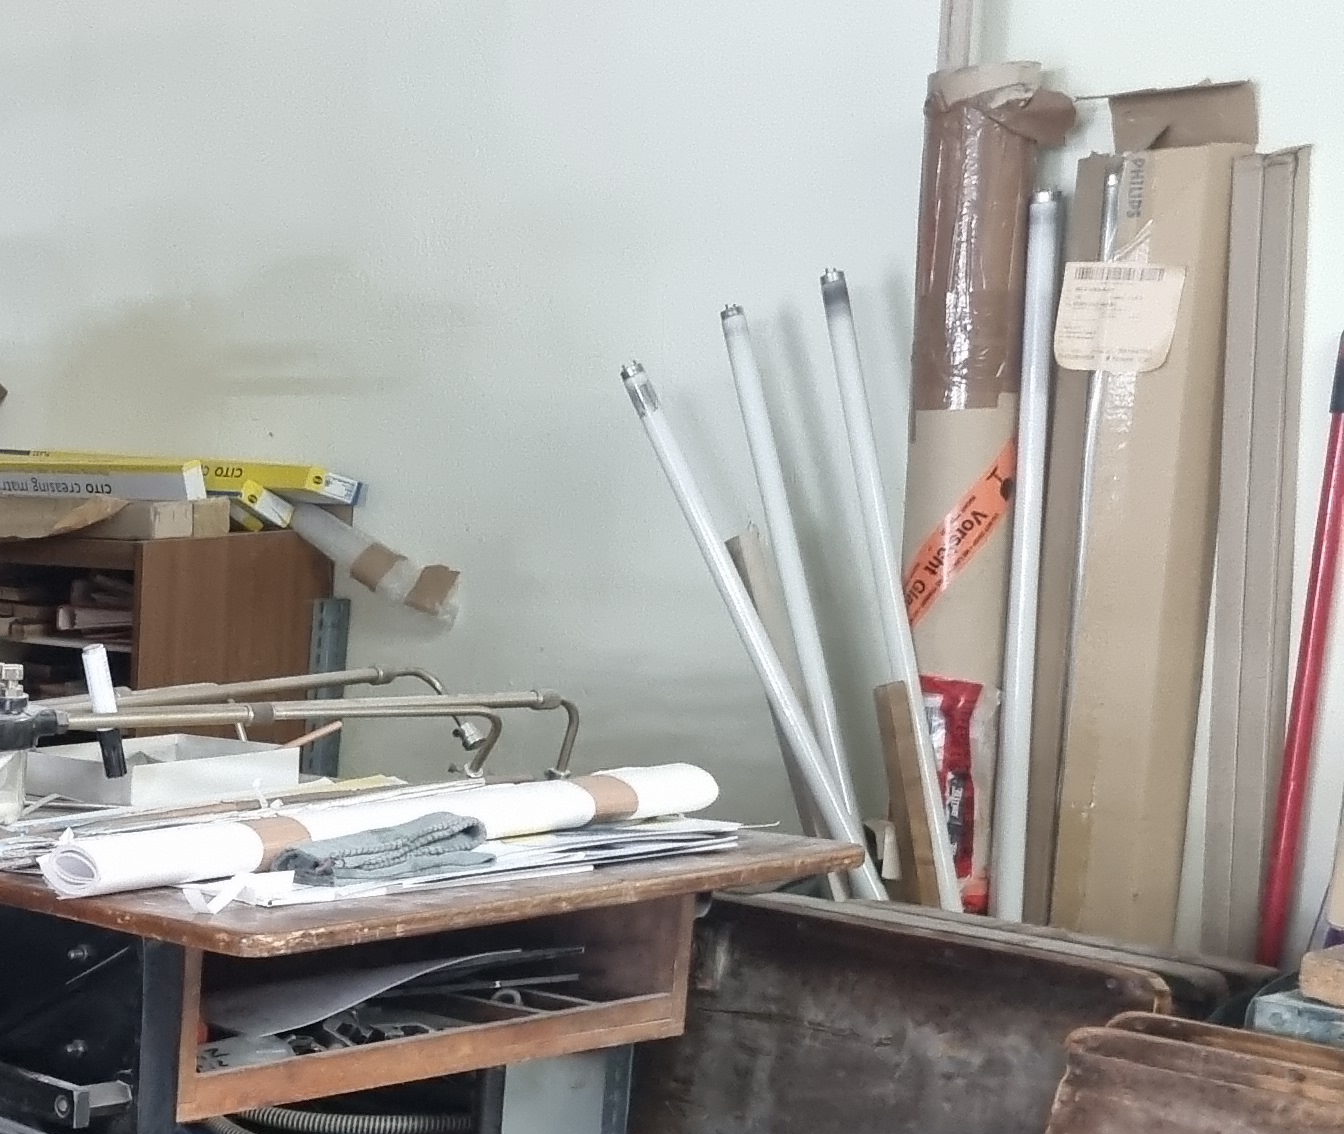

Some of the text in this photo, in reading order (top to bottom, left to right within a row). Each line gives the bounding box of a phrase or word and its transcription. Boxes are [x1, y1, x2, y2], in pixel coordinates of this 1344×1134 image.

[1126, 158, 1146, 218] PHILIPS
[214, 466, 243, 478] CITO
[33, 477, 81, 493] creasing
[86, 483, 112, 494] CITO
